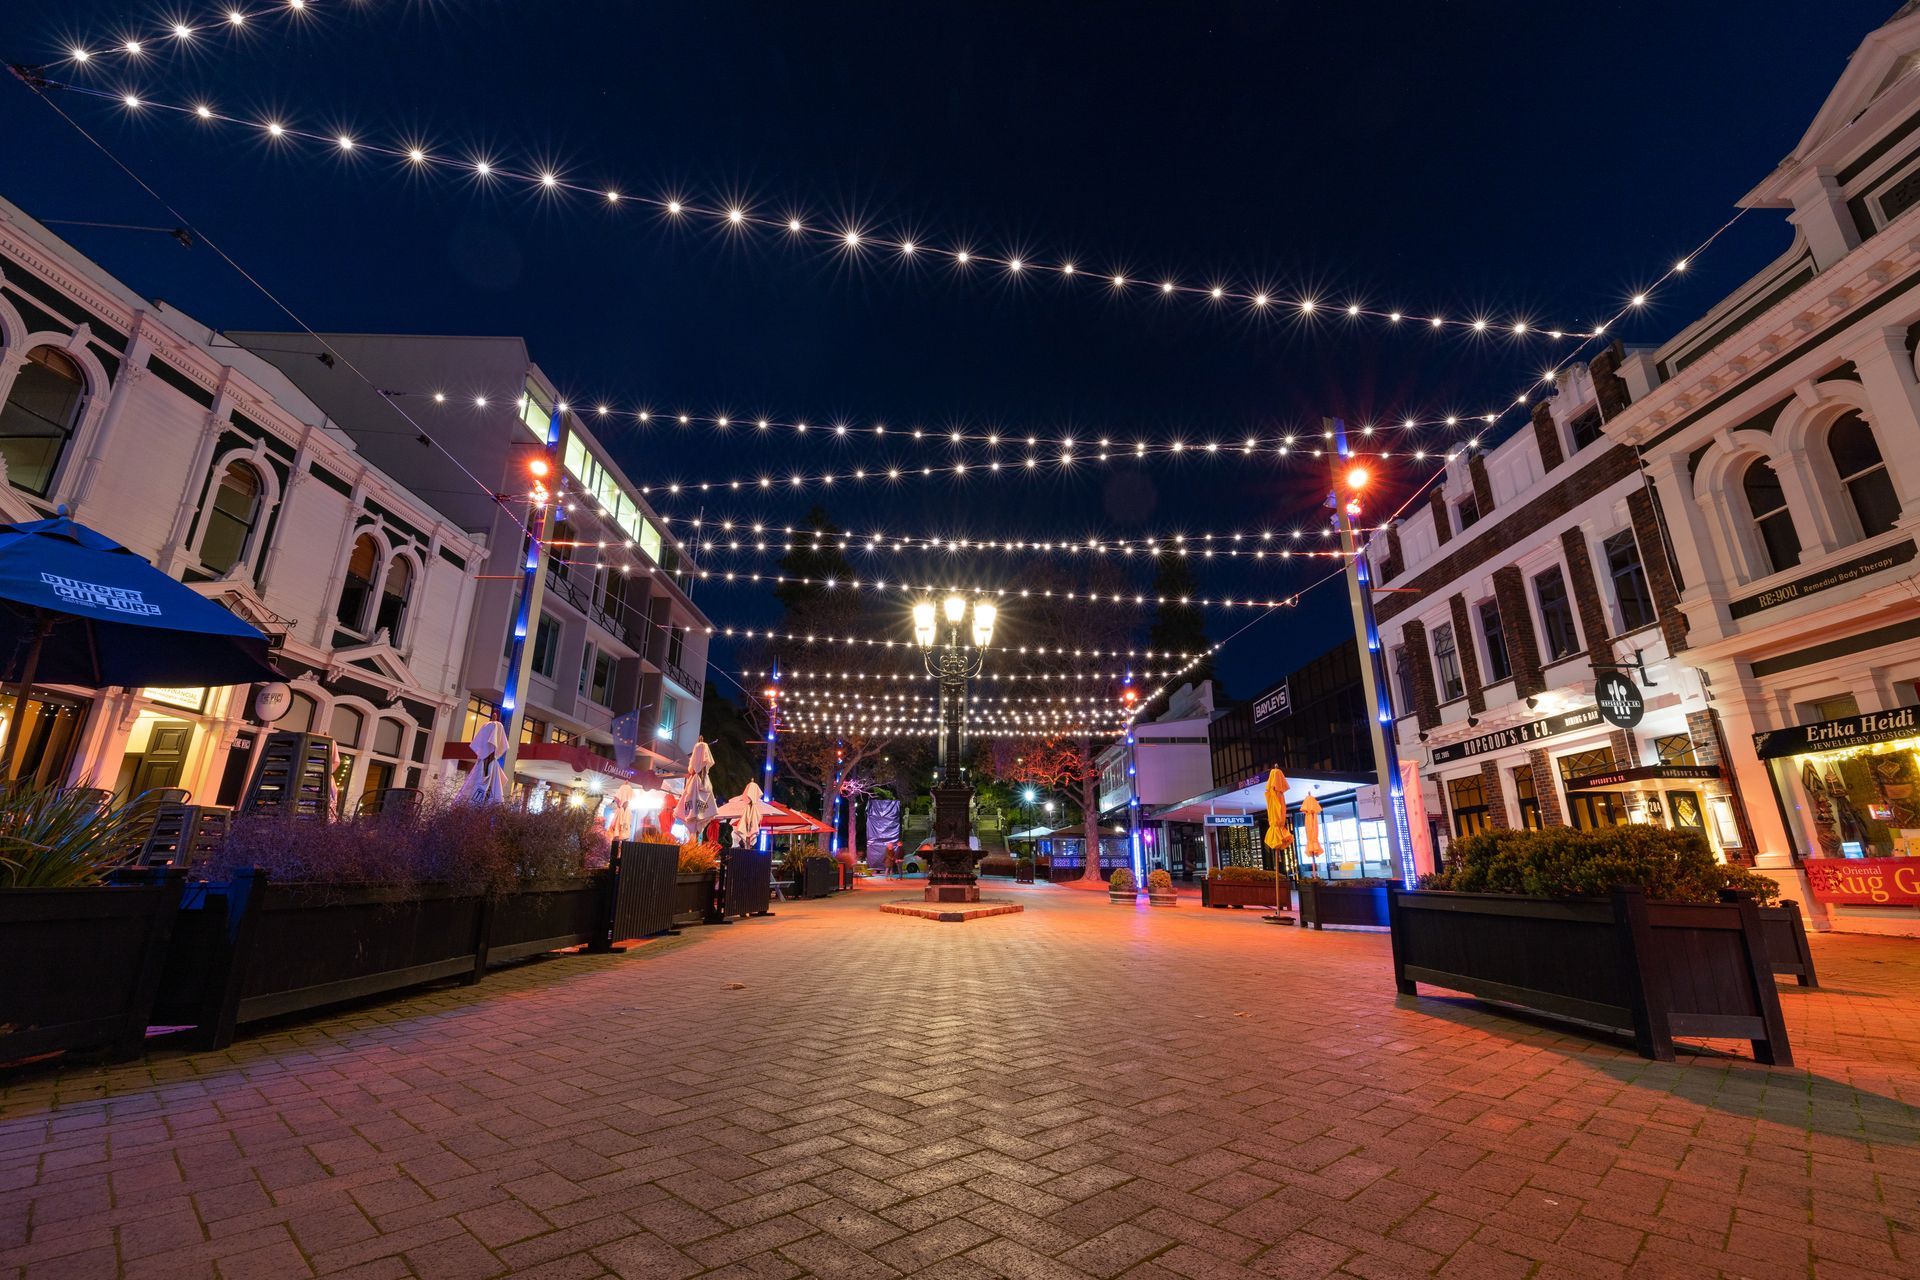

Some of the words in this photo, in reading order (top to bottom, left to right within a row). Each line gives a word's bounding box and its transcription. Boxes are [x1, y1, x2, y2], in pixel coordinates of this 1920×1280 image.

[43, 574, 141, 601] BURGER
[1758, 584, 1798, 608] RE:YOU
[1803, 575, 1837, 593] Remedial
[1838, 569, 1858, 582] Body
[1859, 556, 1893, 574] Therapy
[54, 586, 160, 614] CULTURE
[1255, 691, 1286, 719] BAYLEYS
[1464, 730, 1516, 756] HOPGOOD'S
[1521, 726, 1528, 740] &
[1534, 720, 1552, 738] CO.
[1564, 714, 1582, 727] DINING
[1583, 713, 1587, 722] &
[1587, 710, 1598, 721] BAR
[1806, 721, 1855, 743] Erika
[1860, 709, 1915, 735] Heidi
[1812, 734, 1870, 751] JEWELLERY
[1590, 776, 1613, 786] HOPGOOD'S
[1618, 774, 1626, 782] CO.
[1662, 769, 1693, 777] HOPGOOD'S
[1648, 801, 1662, 813] 284
[1842, 866, 1882, 875] Oriental
[1824, 868, 1889, 902] Rug
